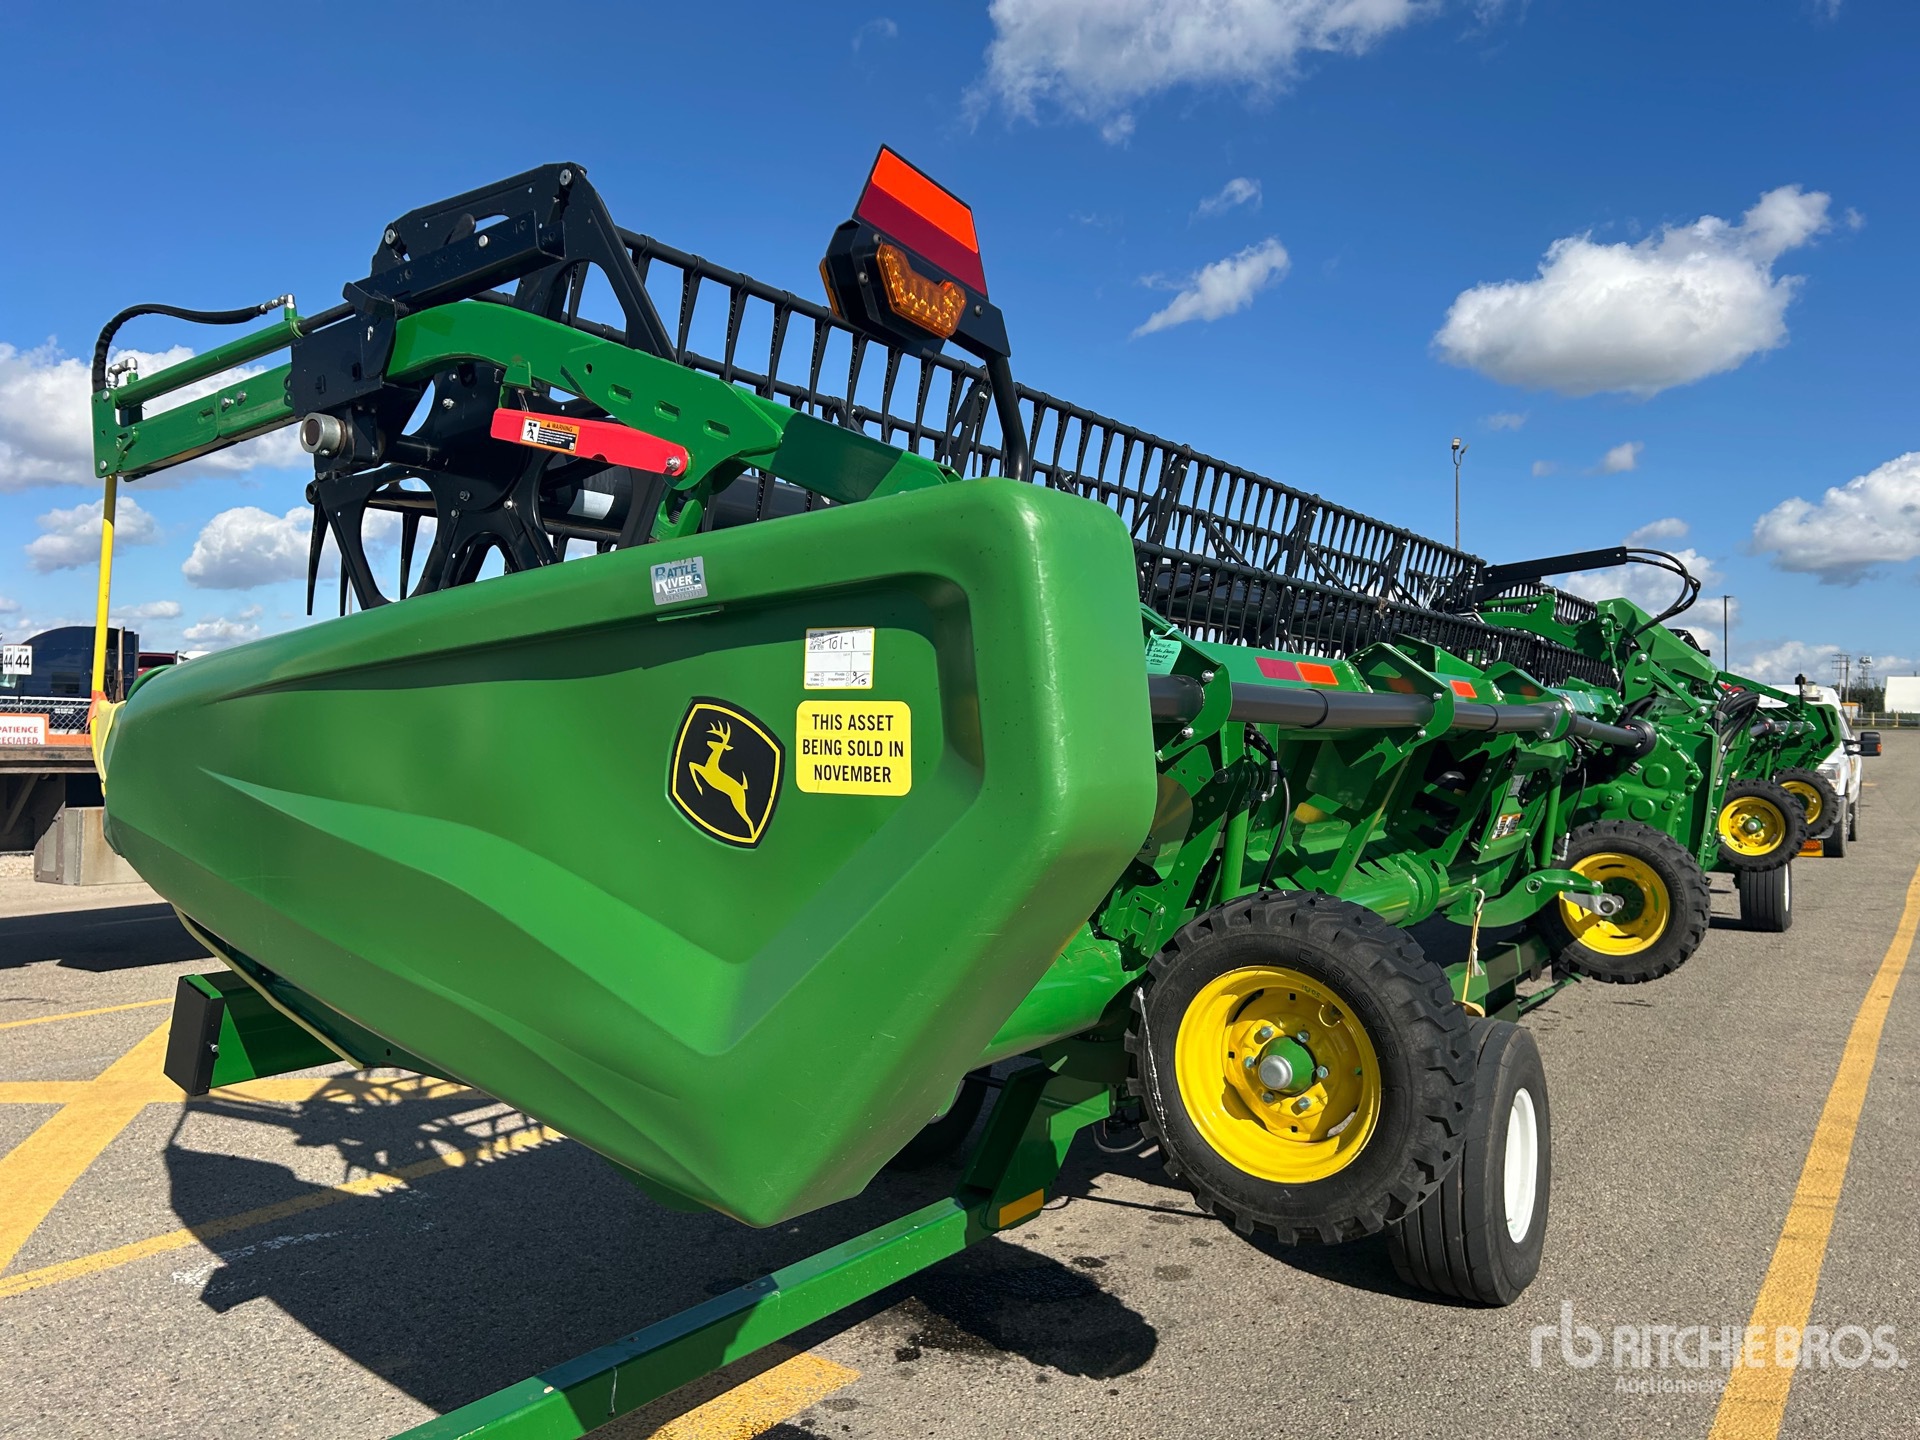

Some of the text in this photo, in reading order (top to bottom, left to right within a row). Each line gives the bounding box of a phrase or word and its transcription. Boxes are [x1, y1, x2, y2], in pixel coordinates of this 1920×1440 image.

[655, 563, 697, 578] BATTLE
[655, 575, 692, 595] RIVER
[15, 654, 30, 668] 44
[812, 714, 893, 731] THIS ASSET
[802, 739, 904, 757] BEING SOLD IN
[814, 764, 891, 783] NOVEMBER
